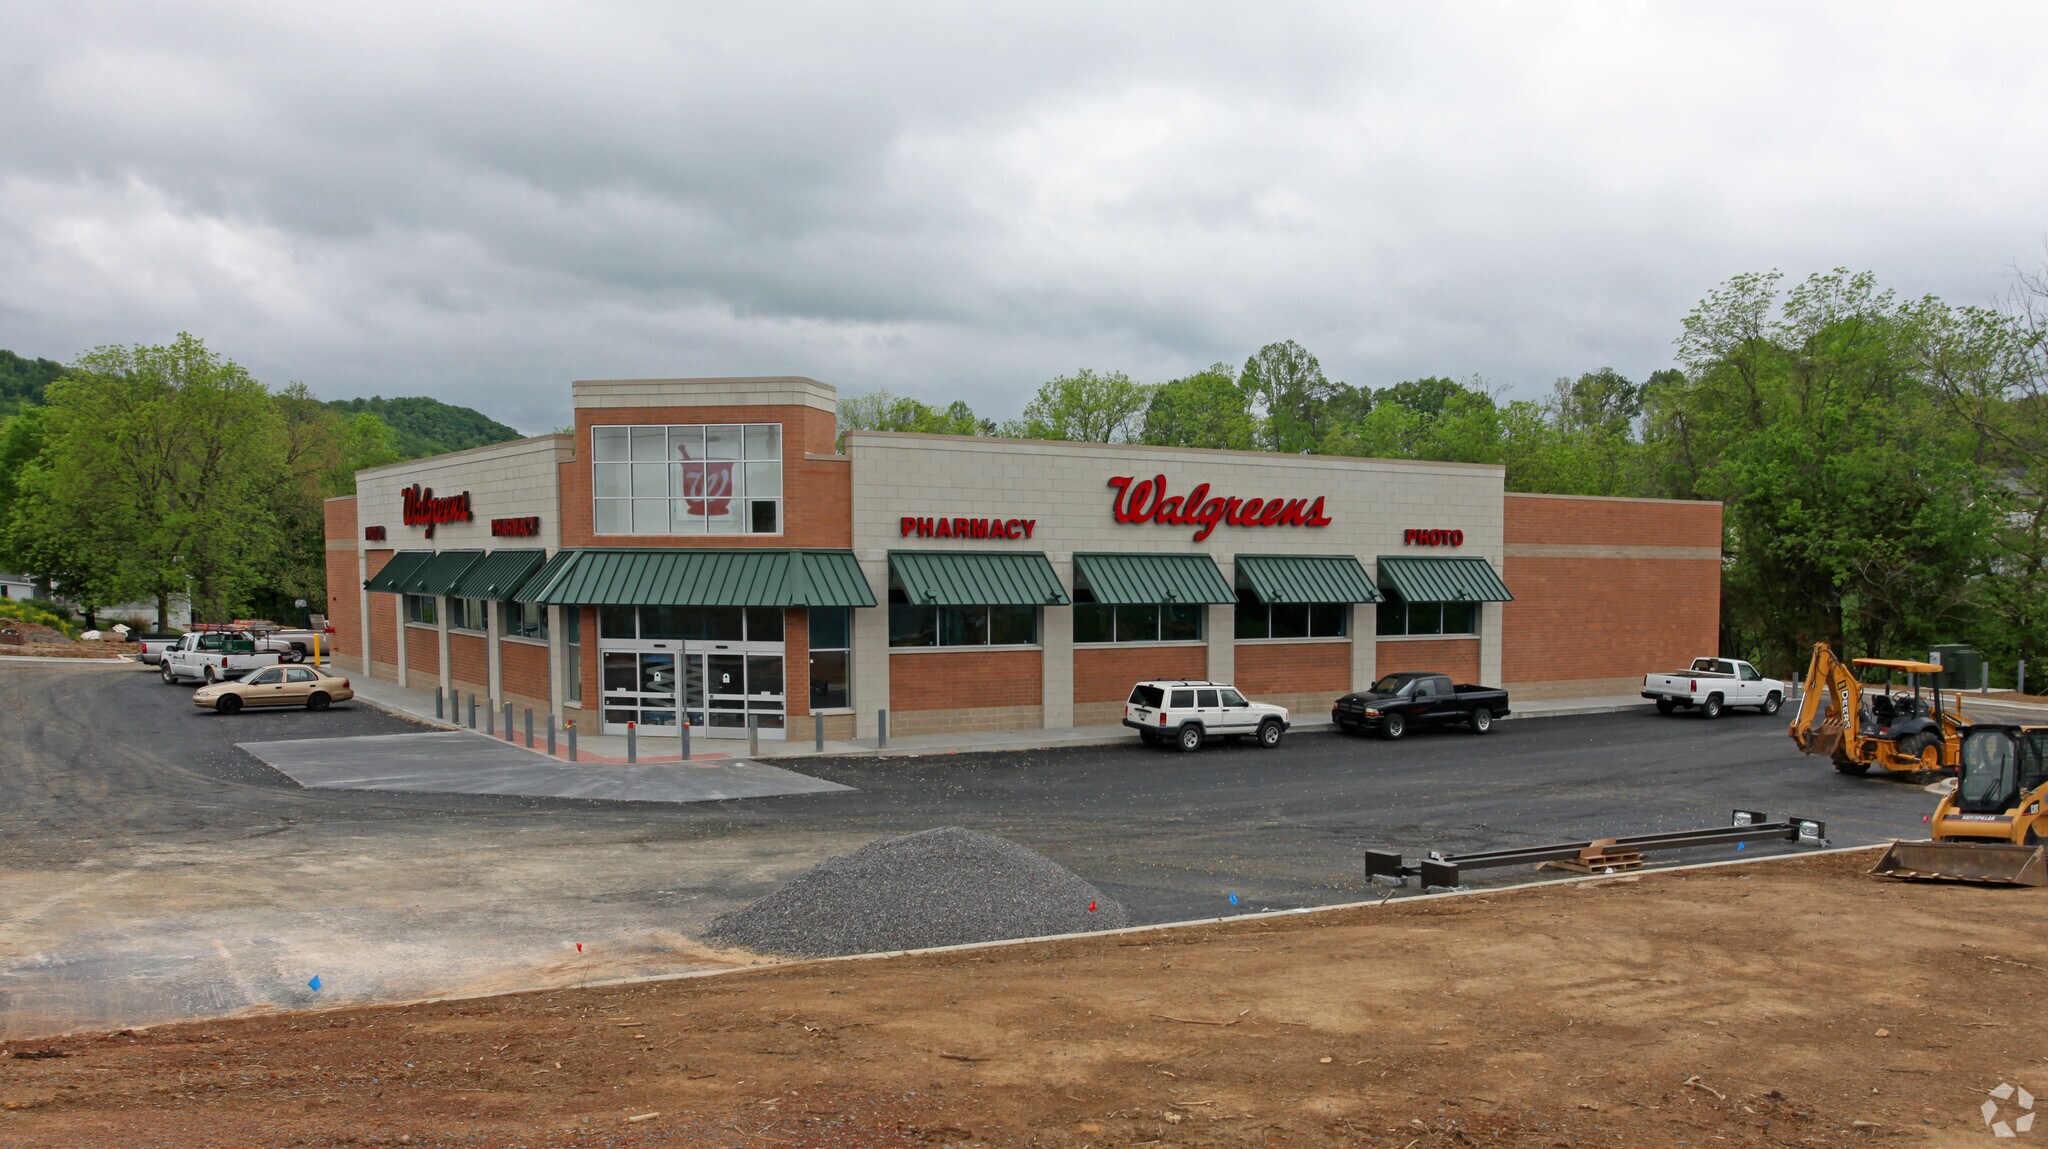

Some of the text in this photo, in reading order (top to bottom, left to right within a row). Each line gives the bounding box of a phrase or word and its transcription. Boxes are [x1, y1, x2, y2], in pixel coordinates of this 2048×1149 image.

[401, 483, 473, 539] Walgreens
[1107, 474, 1332, 542] Walgreens
[491, 517, 540, 537] PHARMACY
[900, 516, 1036, 539] PHARMACY
[1404, 529, 1464, 546] PHOTO
